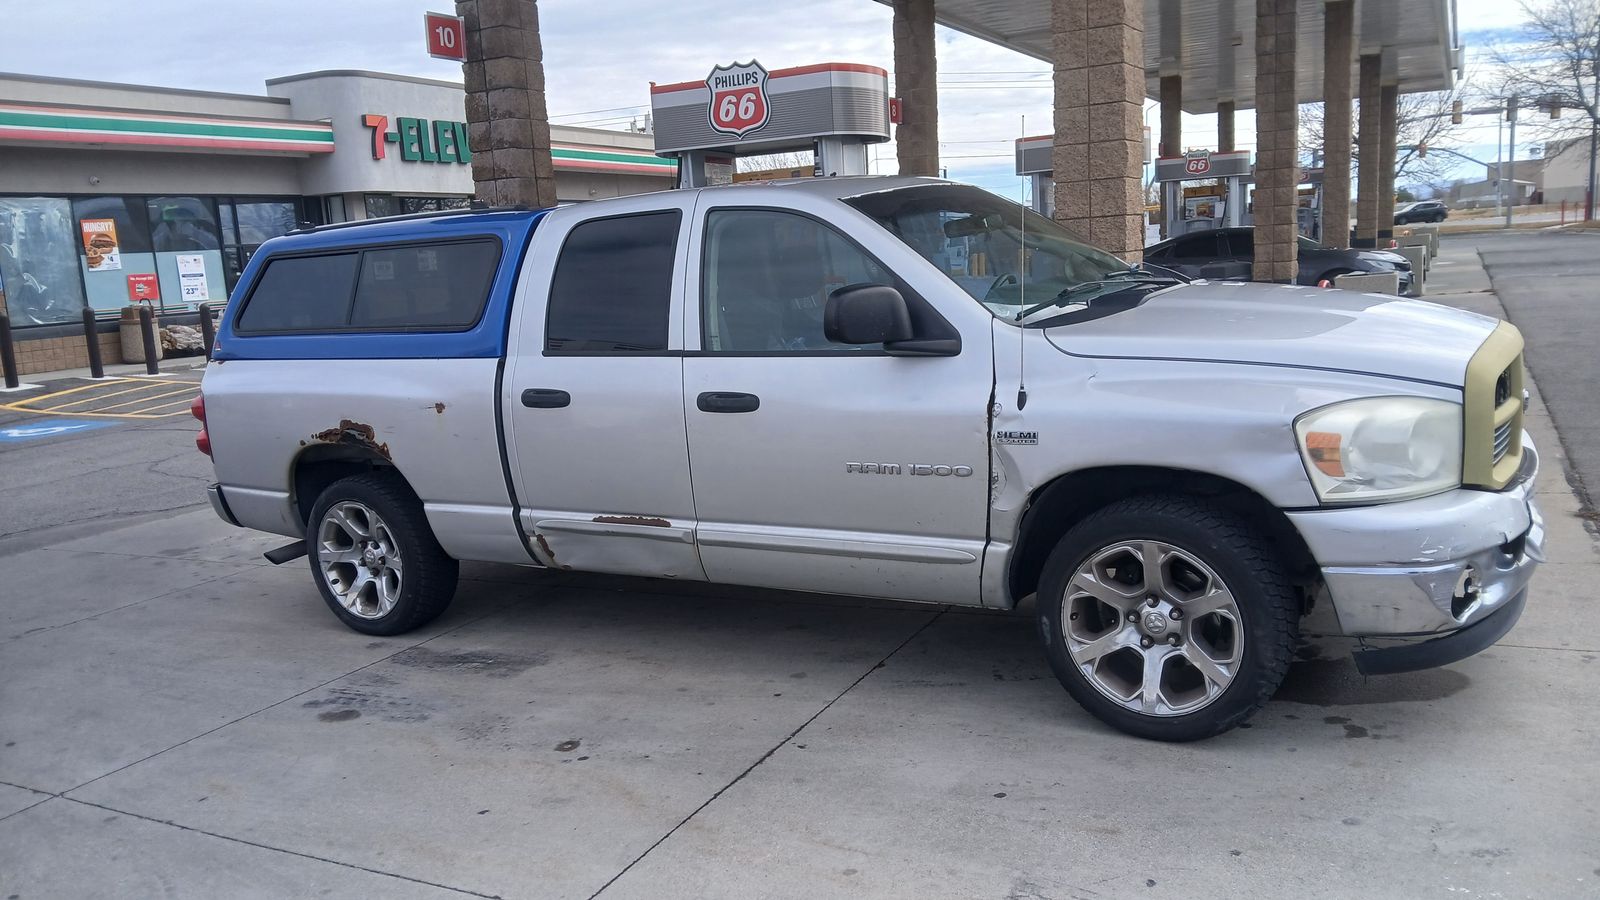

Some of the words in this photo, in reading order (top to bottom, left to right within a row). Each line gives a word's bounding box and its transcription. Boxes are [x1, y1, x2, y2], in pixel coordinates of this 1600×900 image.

[435, 26, 454, 48] 10
[715, 71, 758, 88] PHILLIPS
[719, 92, 757, 122] 66
[1190, 160, 1206, 171] 66
[82, 221, 113, 233] HUNGRY?
[846, 461, 902, 475] RAM
[907, 462, 973, 478] 1500
